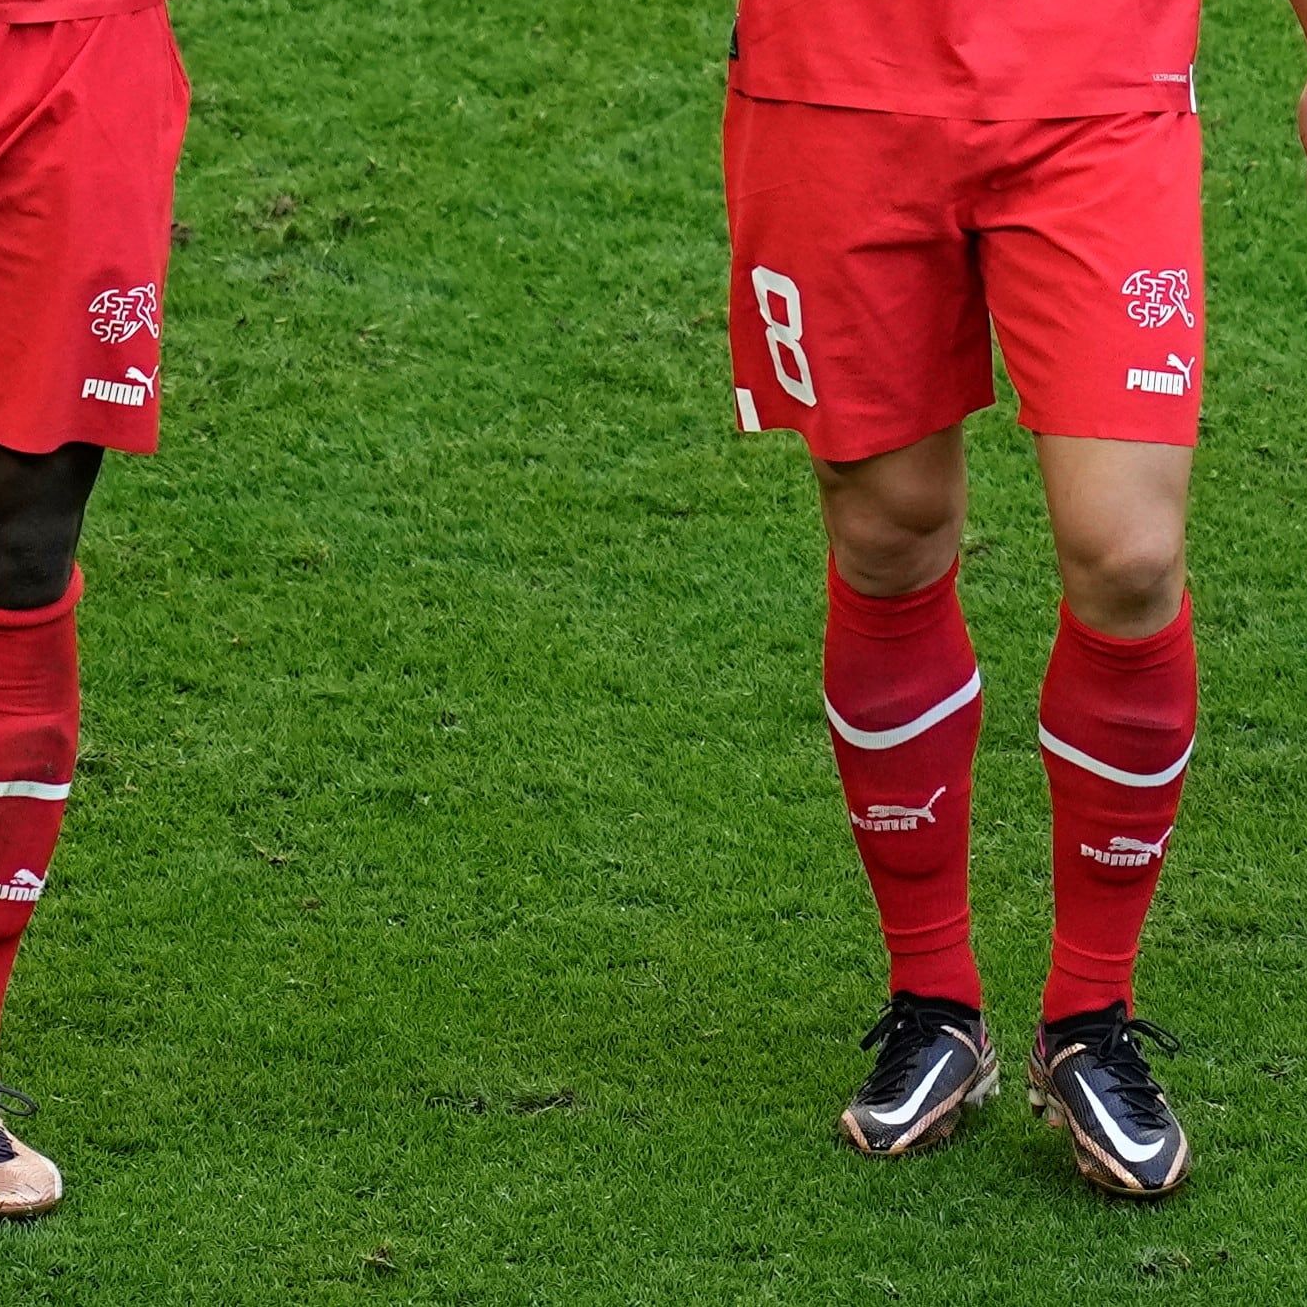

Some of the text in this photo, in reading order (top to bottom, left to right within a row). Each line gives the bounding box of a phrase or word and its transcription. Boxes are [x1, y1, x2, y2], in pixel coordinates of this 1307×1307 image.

[751, 265, 817, 407] 8
[81, 378, 146, 406] PUMA
[1126, 368, 1184, 396] PUMA
[1080, 843, 1152, 867] PUMA
